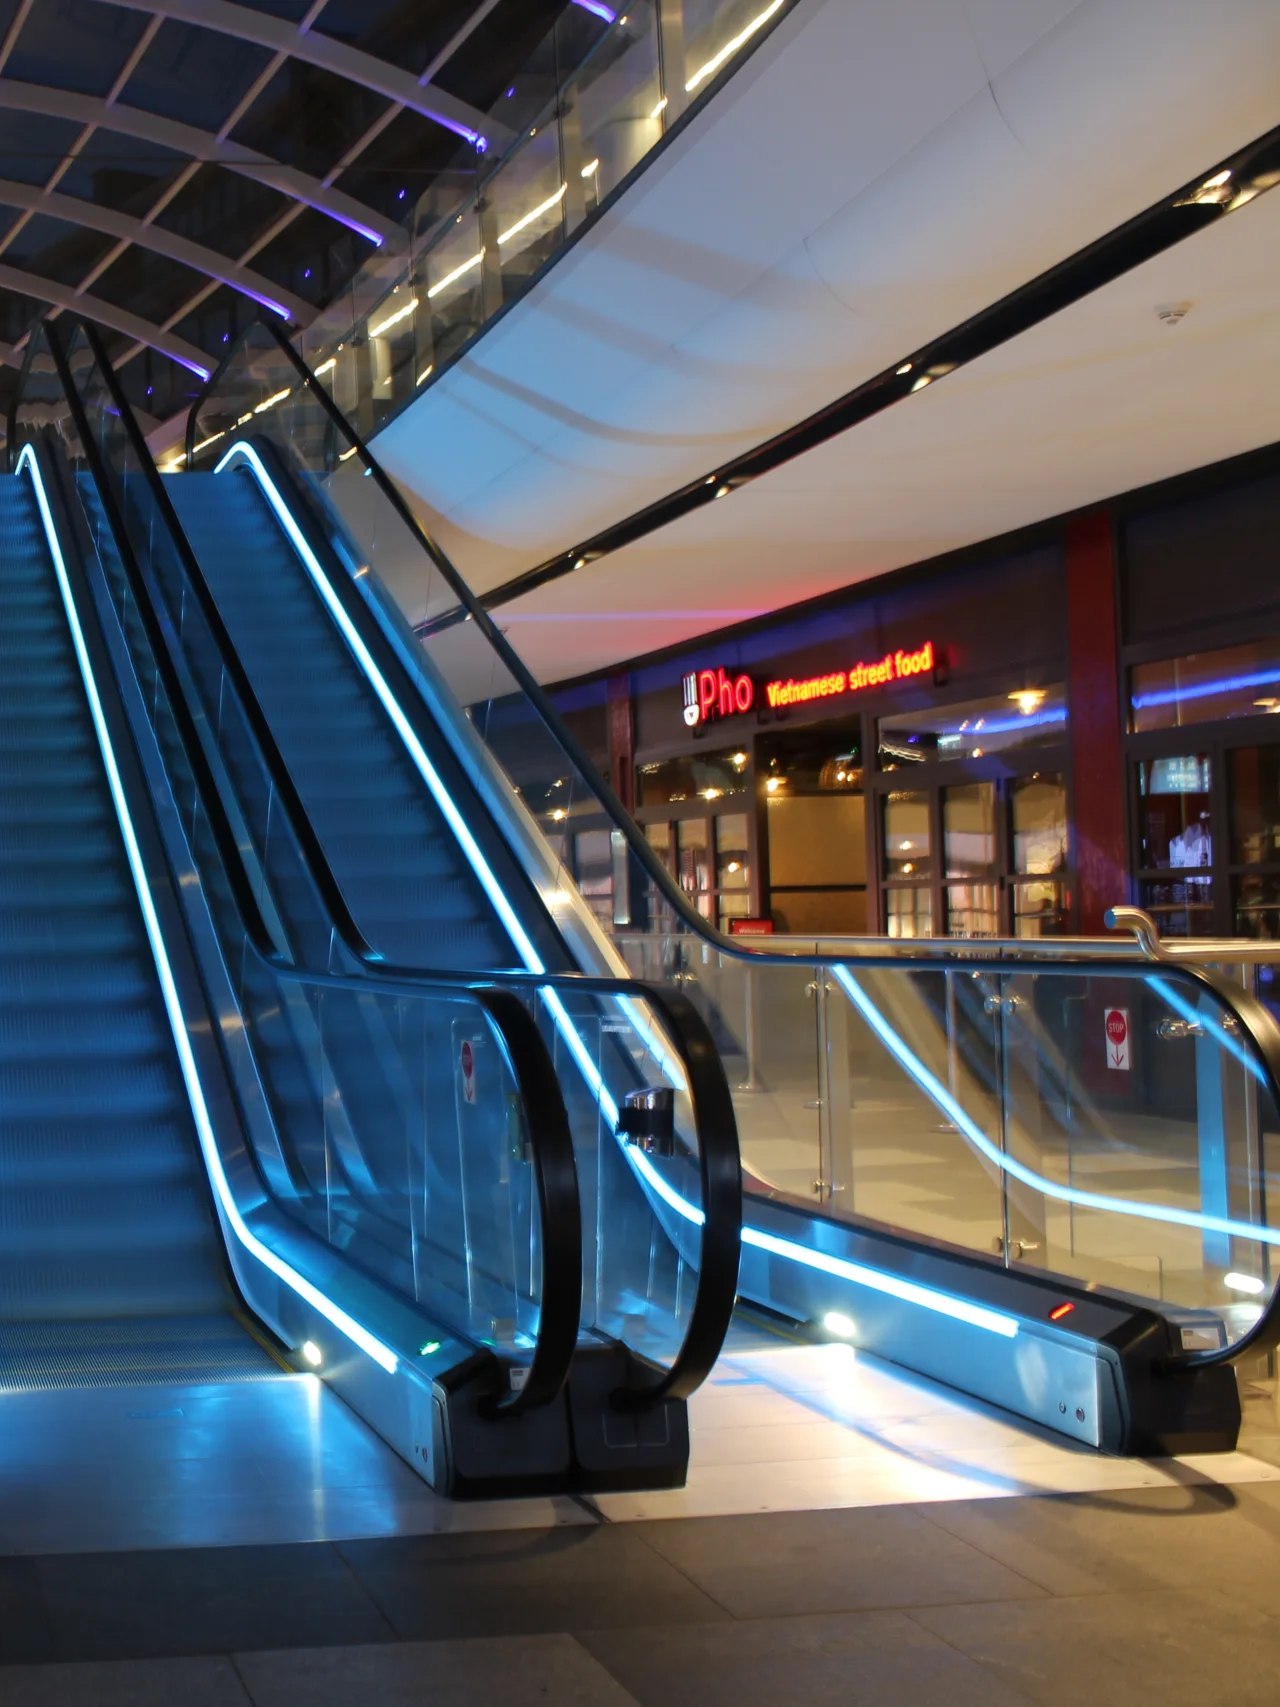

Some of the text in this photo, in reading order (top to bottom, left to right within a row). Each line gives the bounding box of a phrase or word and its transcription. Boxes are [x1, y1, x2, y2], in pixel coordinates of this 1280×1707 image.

[698, 642, 933, 720] Pho Vietnamese street food
[1108, 1022, 1125, 1033] STOP
